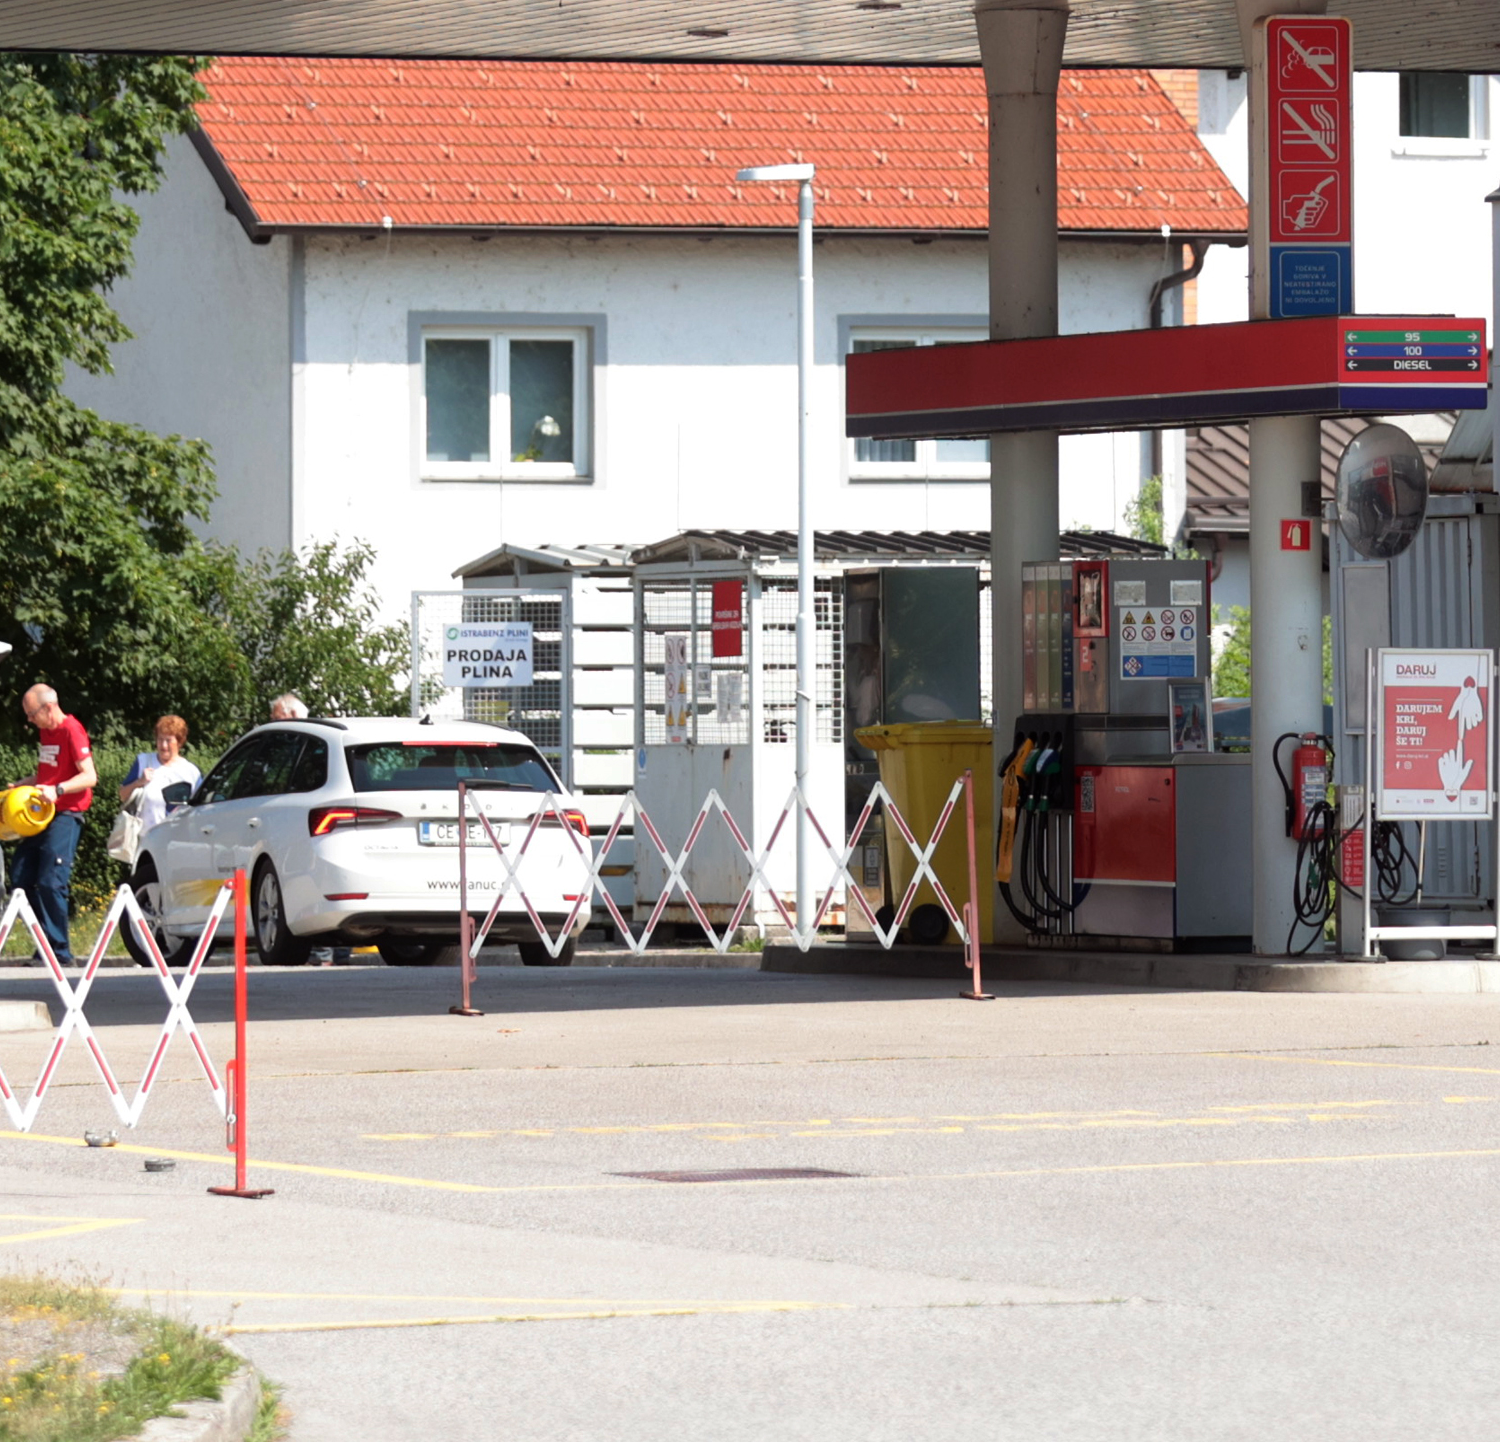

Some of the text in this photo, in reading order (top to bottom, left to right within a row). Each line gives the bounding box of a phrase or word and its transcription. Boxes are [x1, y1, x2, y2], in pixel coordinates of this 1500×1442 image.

[1405, 332, 1421, 341] 95
[1403, 346, 1422, 355] 100
[1393, 360, 1432, 370] DIESEL
[460, 629, 529, 638] ISTRABENZ PLINI
[447, 649, 527, 662] PRODAJA
[461, 665, 513, 678] PLINA
[1396, 663, 1437, 675] DARUJ
[1396, 704, 1443, 715] DARUJEM
[1396, 715, 1418, 725] KRI,
[1396, 726, 1427, 737] DARUJ
[1396, 735, 1423, 746] ŠE TI!
